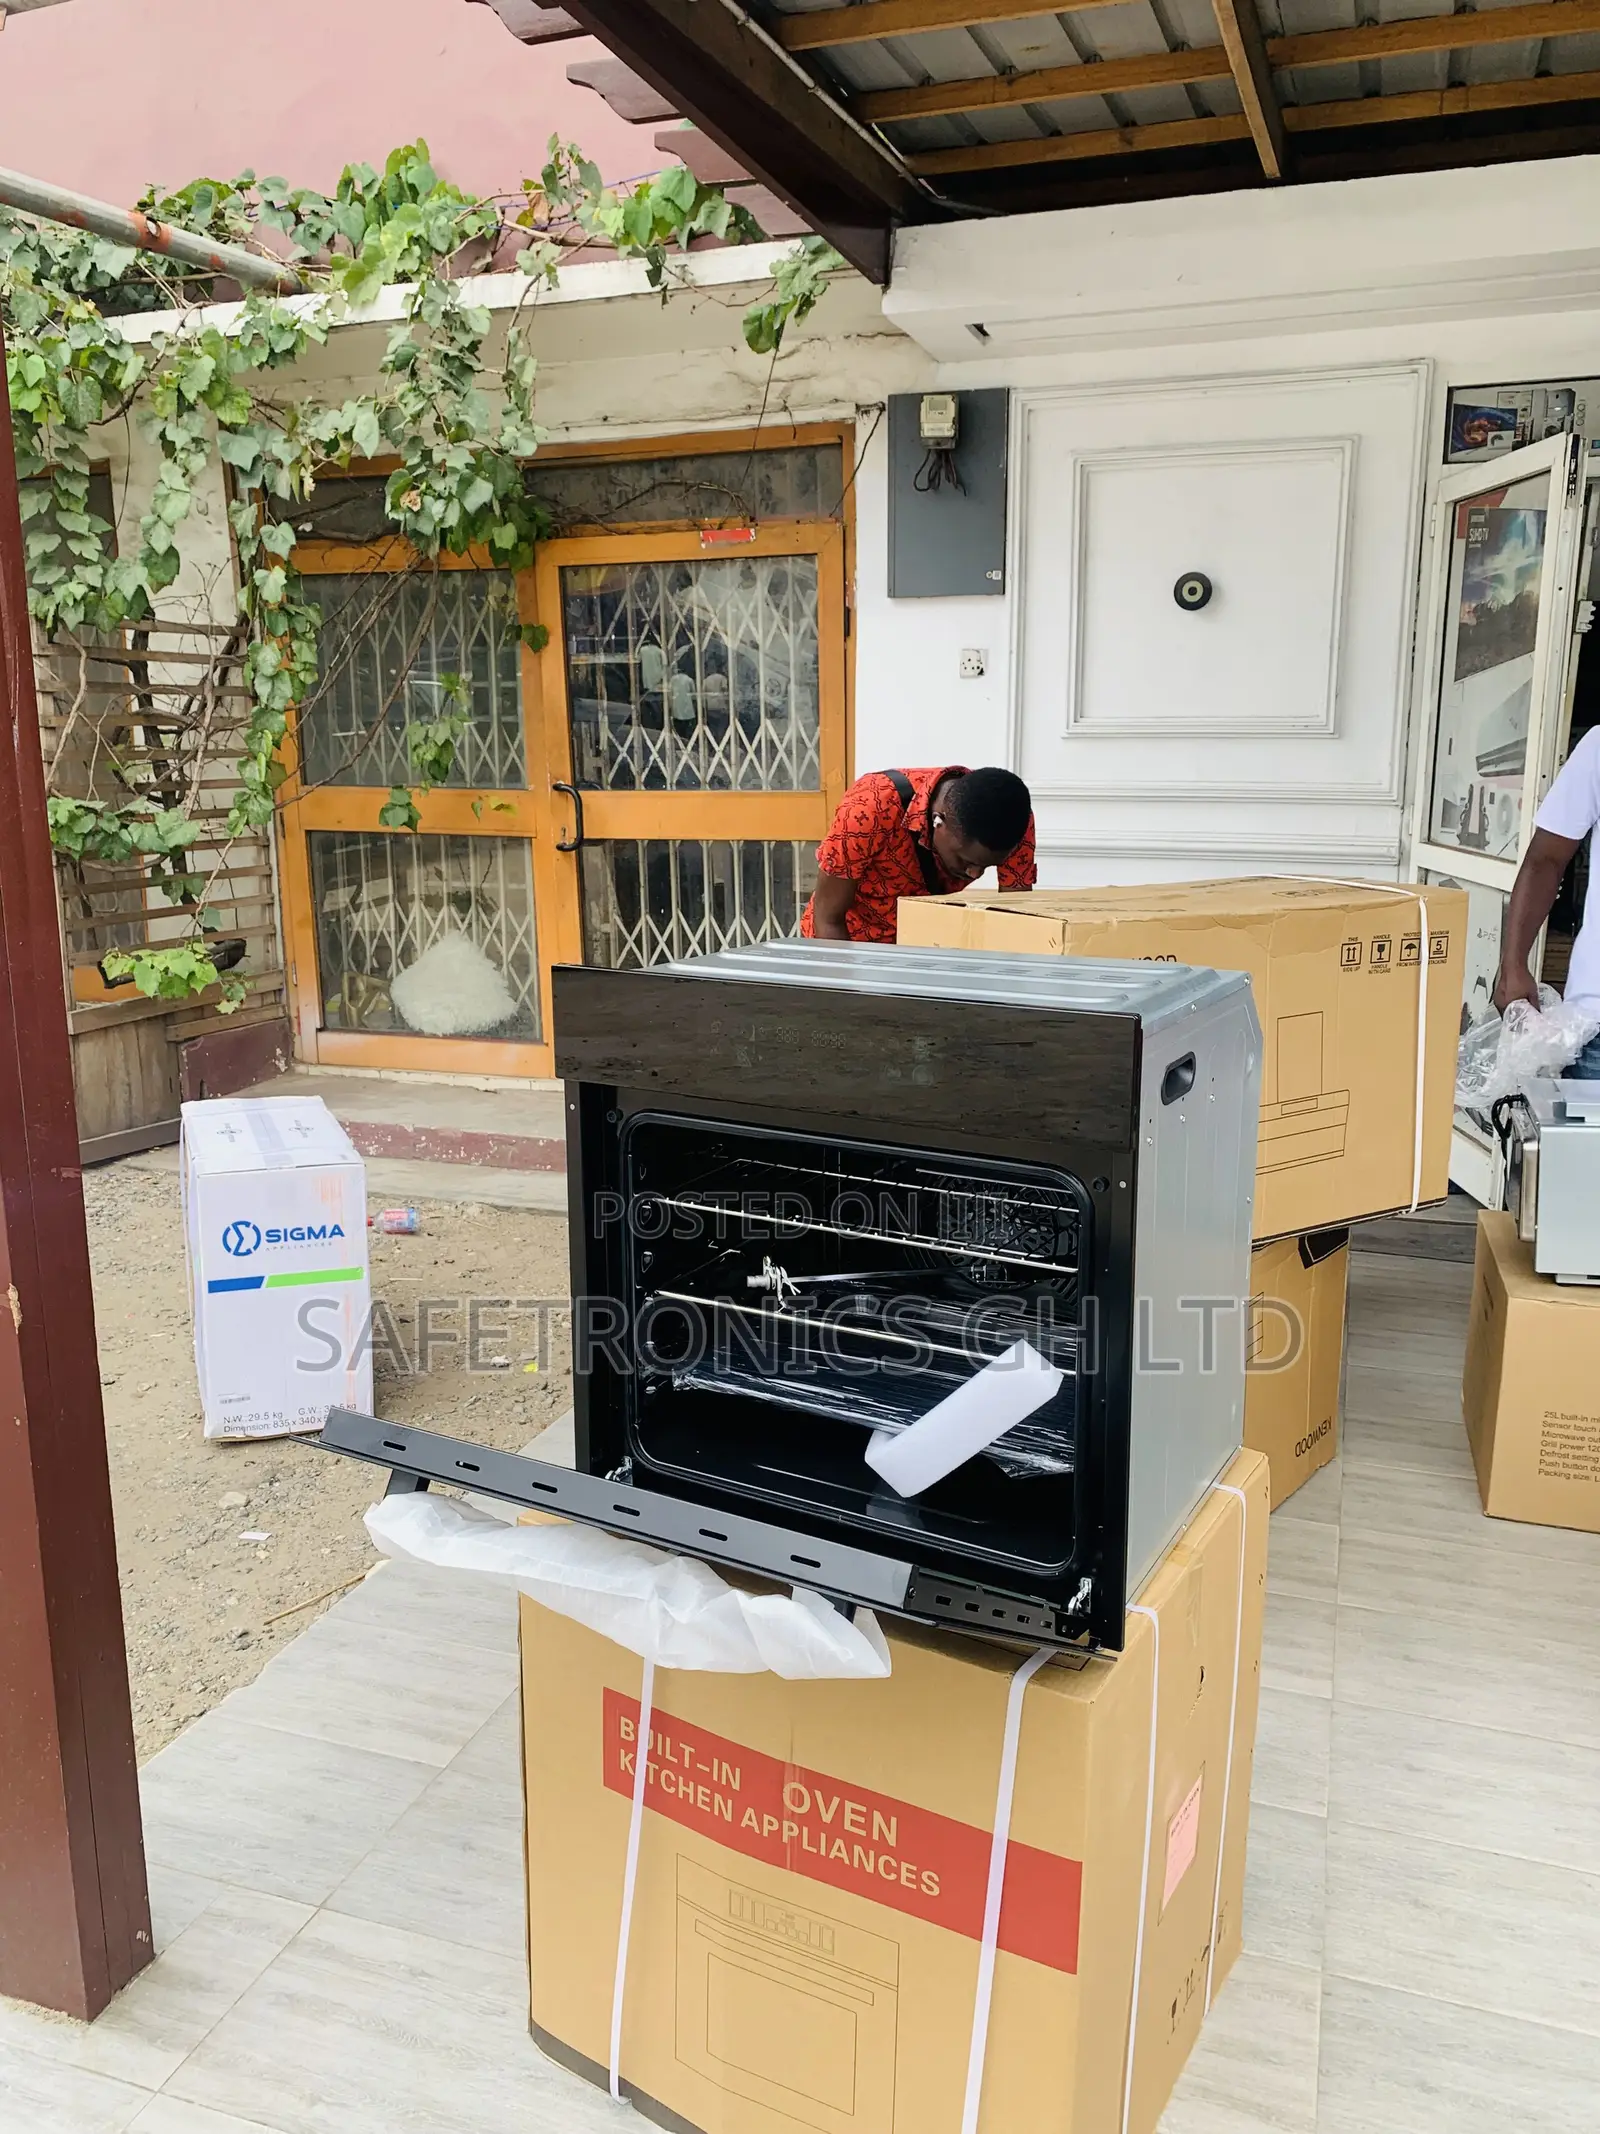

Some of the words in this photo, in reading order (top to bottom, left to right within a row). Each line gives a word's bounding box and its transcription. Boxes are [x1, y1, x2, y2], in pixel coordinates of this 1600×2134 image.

[1436, 940, 1442, 951] 5
[265, 1224, 345, 1243] SIGMA
[273, 1419, 290, 1429] 835
[1542, 1420, 1571, 1430] Sensor
[1541, 1430, 1586, 1442] Microwave
[1540, 1449, 1570, 1459] Defrost
[1539, 1458, 1560, 1468] Push
[1538, 1468, 1571, 1480] Packing
[782, 1781, 897, 1847] OVEN
[619, 1748, 733, 1822] KTCHEN
[740, 1806, 941, 1897] APPLIANCES
